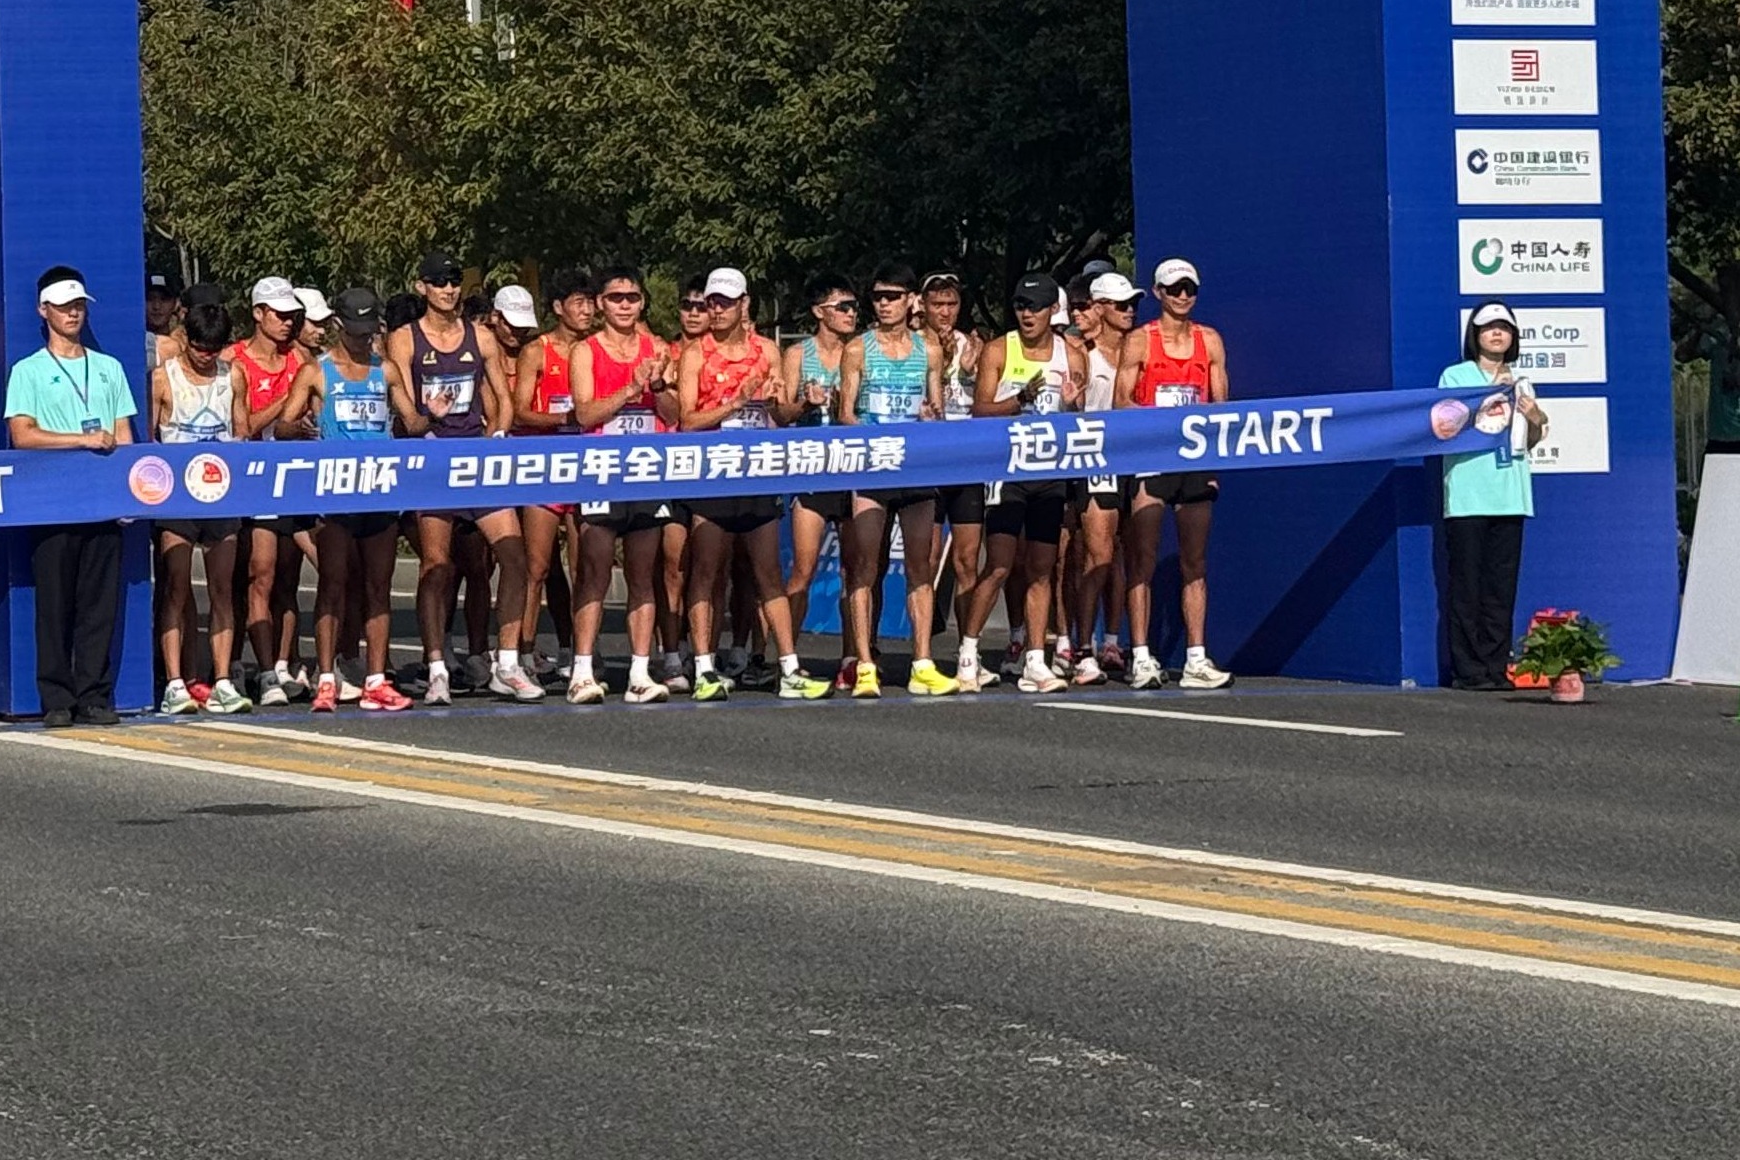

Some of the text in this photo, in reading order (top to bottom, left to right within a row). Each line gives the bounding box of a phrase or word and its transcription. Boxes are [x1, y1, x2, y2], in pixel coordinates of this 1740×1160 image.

[1493, 150, 1590, 165] 中国建设银行
[1510, 240, 1591, 260] 中国人寿
[1511, 261, 1591, 273] CHINA LIFE
[1518, 324, 1580, 343] un Corp
[351, 401, 377, 415] 228
[885, 395, 912, 408] 296
[617, 417, 644, 430] 270
[449, 436, 906, 488] 2026年全国竞走锦标赛
[1006, 417, 1108, 474] 起点
[1178, 407, 1334, 460] START
